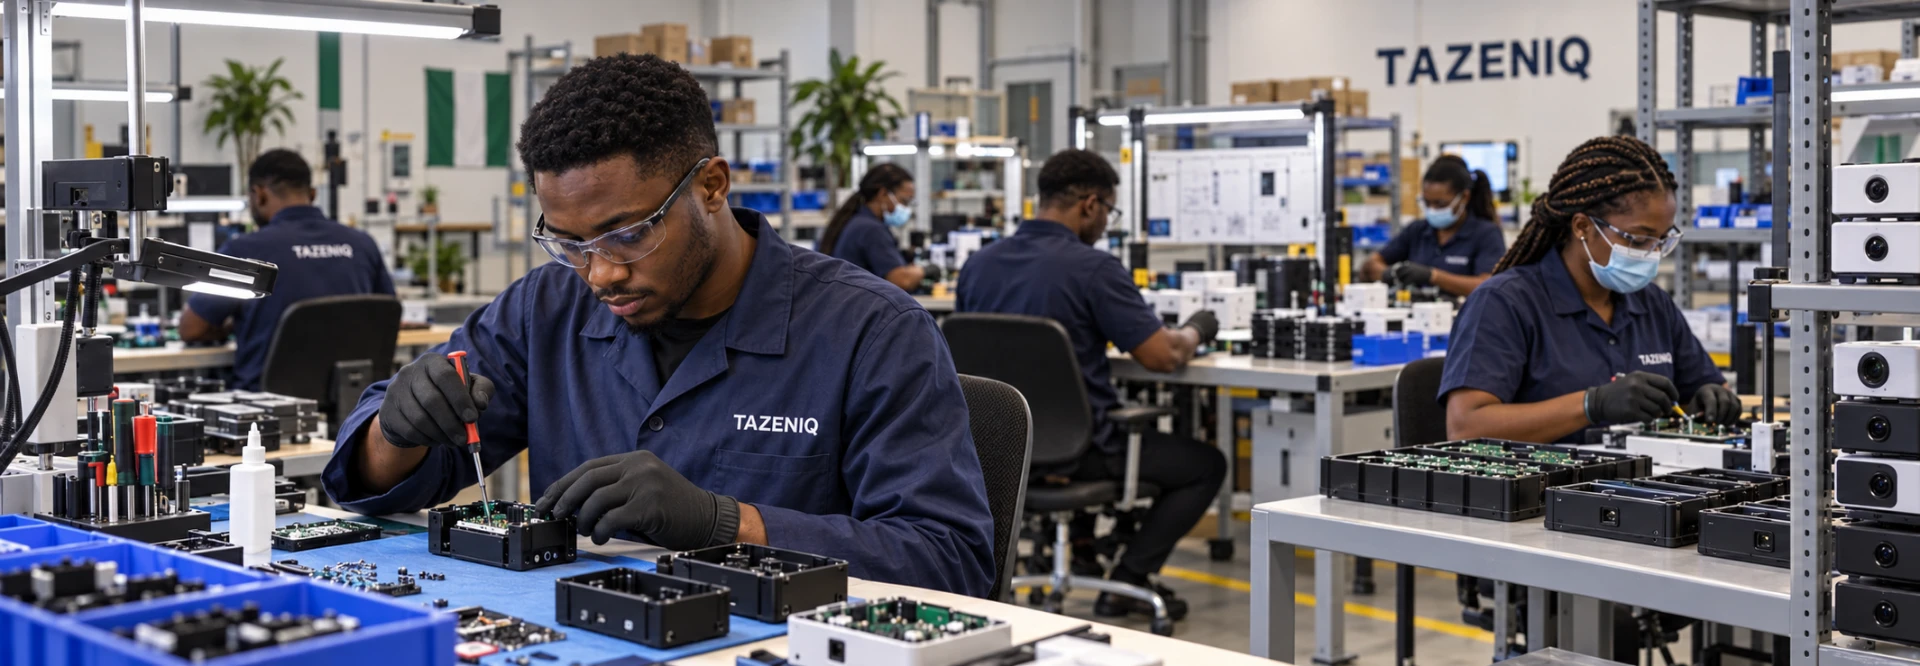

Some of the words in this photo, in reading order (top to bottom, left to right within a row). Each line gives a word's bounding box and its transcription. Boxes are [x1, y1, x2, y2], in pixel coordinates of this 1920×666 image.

[1376, 35, 1592, 86] TAZENIQ
[292, 243, 354, 259] TAZENIQ
[733, 414, 819, 436] TAZENIQ
